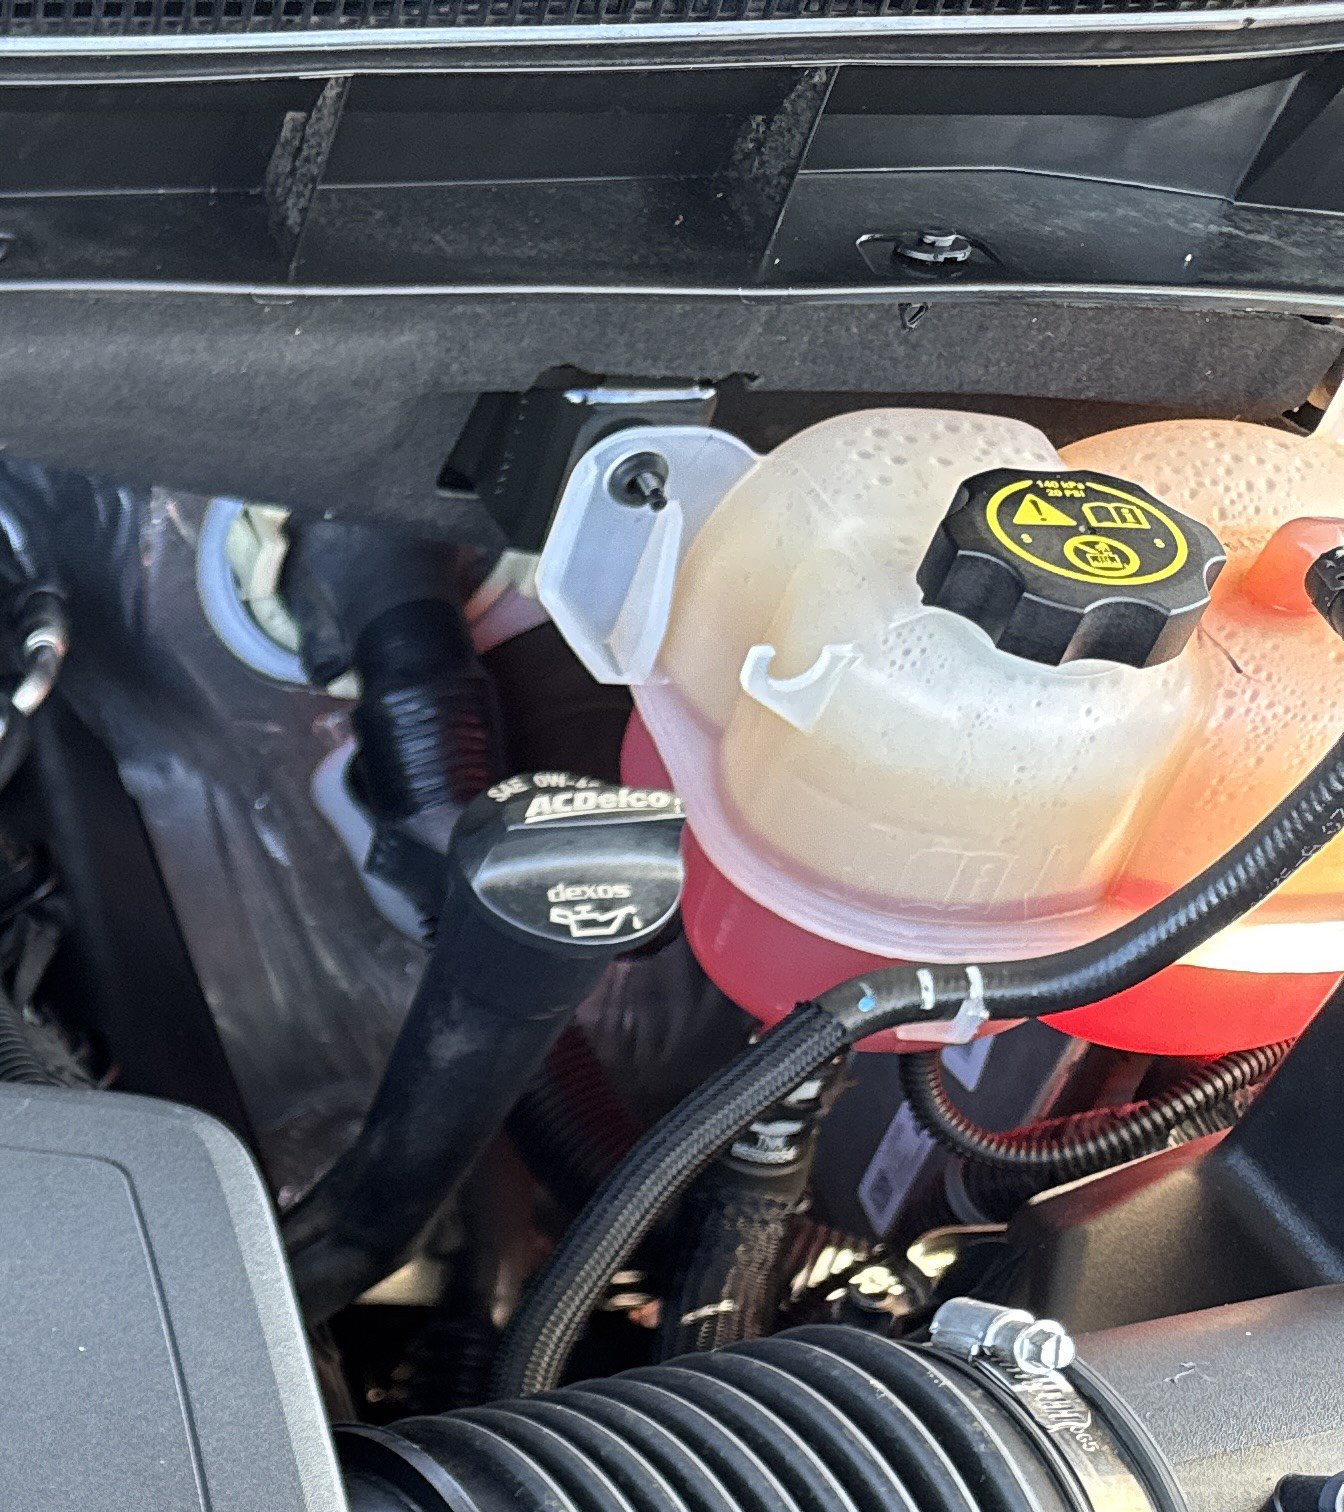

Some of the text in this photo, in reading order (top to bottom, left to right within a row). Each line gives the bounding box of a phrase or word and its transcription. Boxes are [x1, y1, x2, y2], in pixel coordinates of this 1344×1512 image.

[1036, 480, 1059, 490] 140
[1046, 489, 1086, 498] 20 PSI
[487, 776, 530, 802] SAE
[525, 788, 670, 818] ACDelco
[547, 882, 632, 903] dexos
